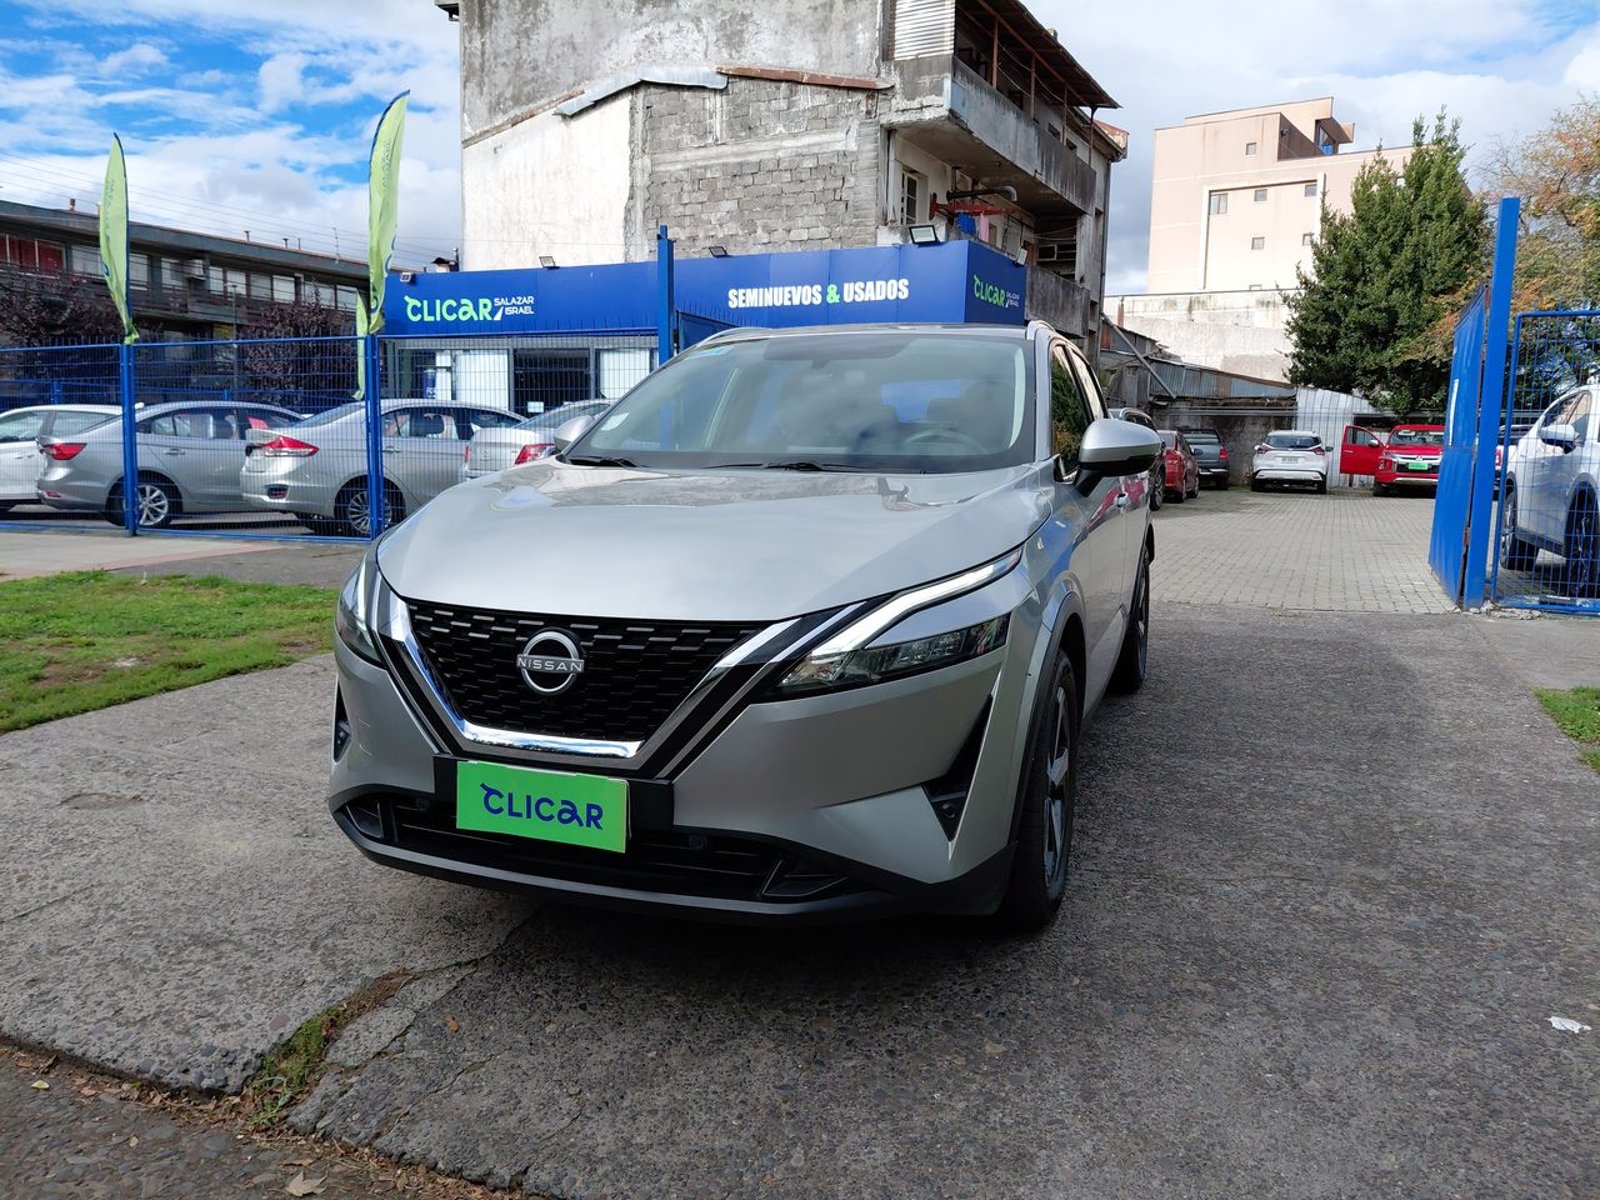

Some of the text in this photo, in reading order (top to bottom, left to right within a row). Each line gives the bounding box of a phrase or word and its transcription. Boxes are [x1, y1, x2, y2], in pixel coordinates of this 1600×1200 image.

[728, 278, 909, 308] SEMINUEVOS & USADOS
[494, 296, 535, 306] SALAZAR
[505, 306, 535, 315] ISRAEL
[518, 657, 582, 672] NISSAN
